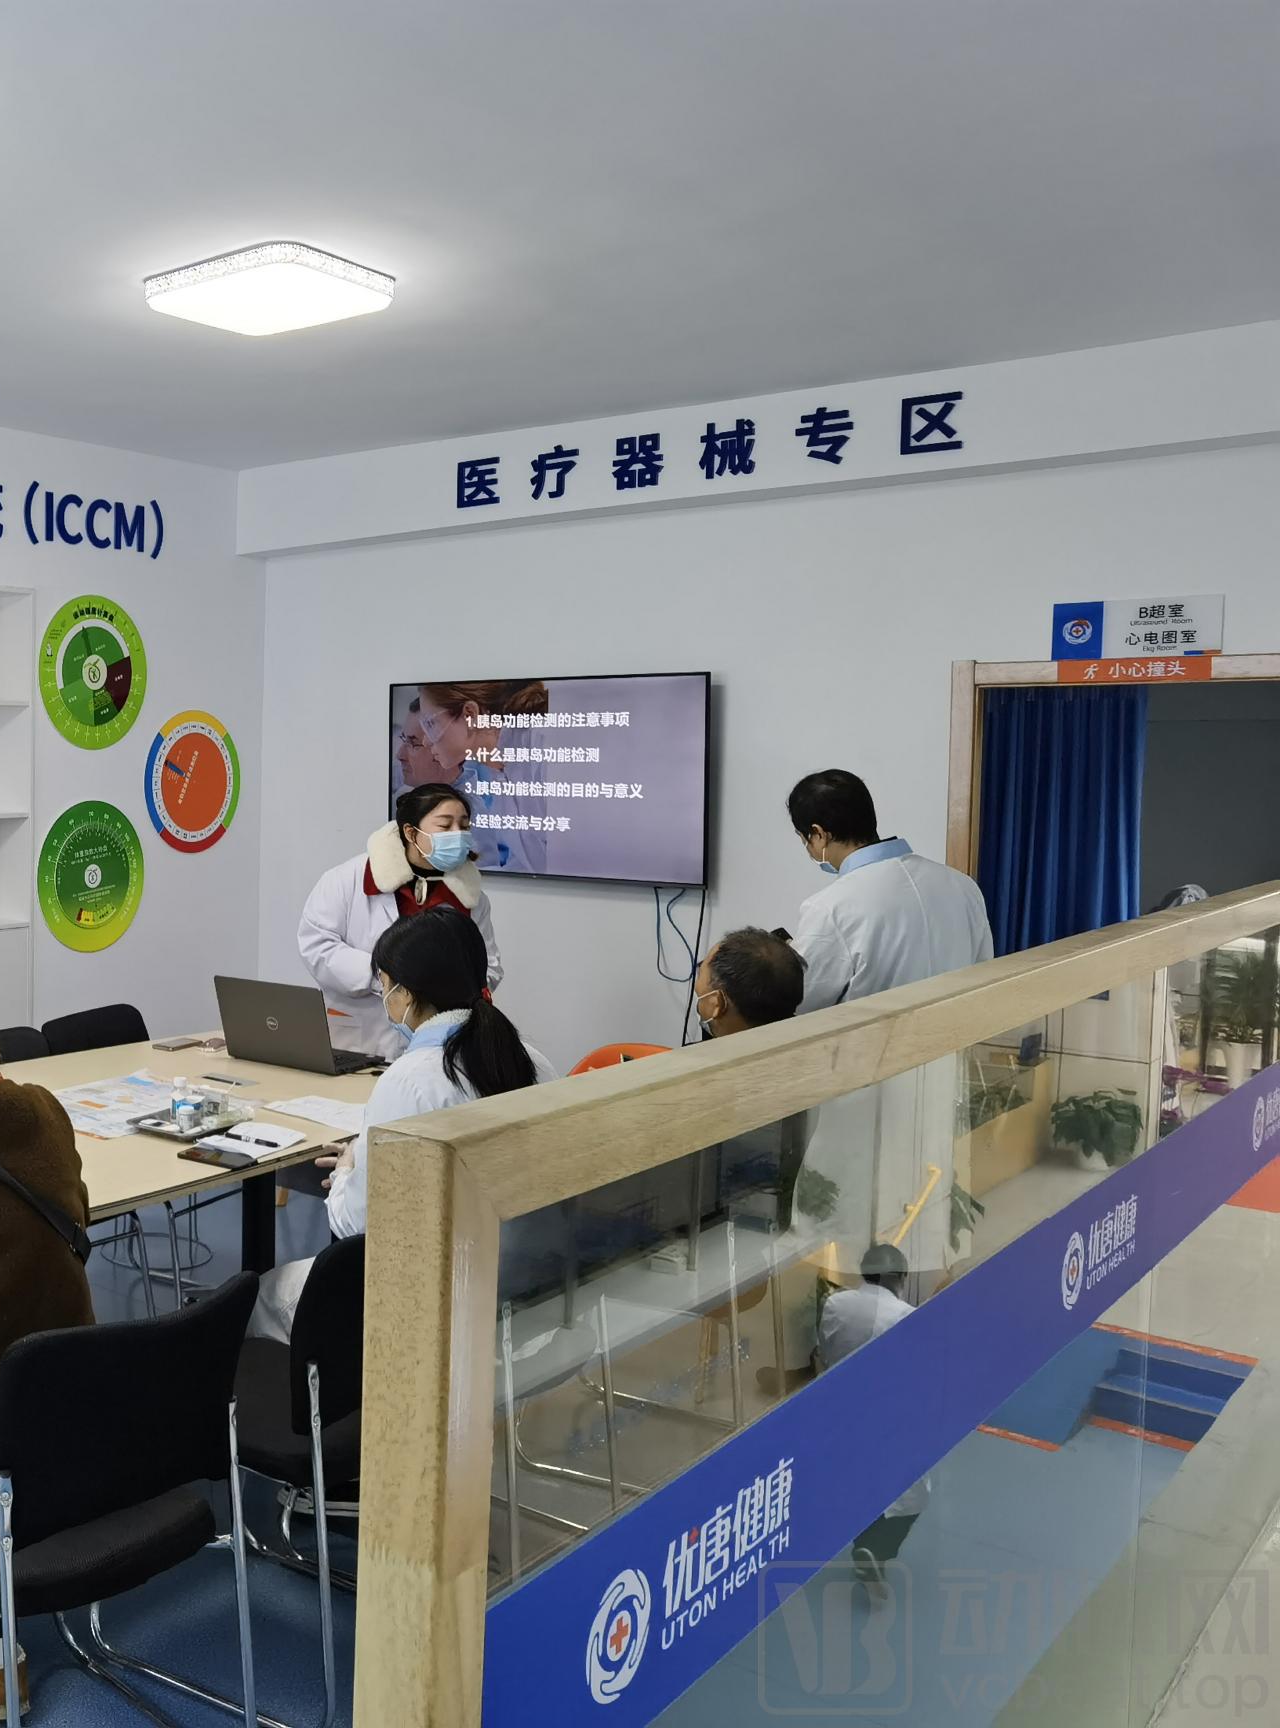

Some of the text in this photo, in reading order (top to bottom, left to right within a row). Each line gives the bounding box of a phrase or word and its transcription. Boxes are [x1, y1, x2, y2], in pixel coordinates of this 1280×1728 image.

[456, 390, 964, 509] 医疗器械专区
[1138, 604, 1185, 619] B超室
[1124, 630, 1198, 646] 心电图室
[1109, 660, 1187, 678] 小心撞头
[465, 711, 630, 729] 1.胰岛功能检测的注意事项
[465, 747, 600, 763] 2.什么是胰岛功能检测
[464, 781, 644, 799] 3.胰岛功能检测的目的与意义
[469, 814, 571, 832] .经验交流与分享
[1088, 1194, 1138, 1271] 优唐健康
[1086, 1239, 1136, 1290] UTON HEALTH
[662, 1457, 794, 1619] 优唐健康
[661, 1526, 790, 1650] UTON HEALTH
